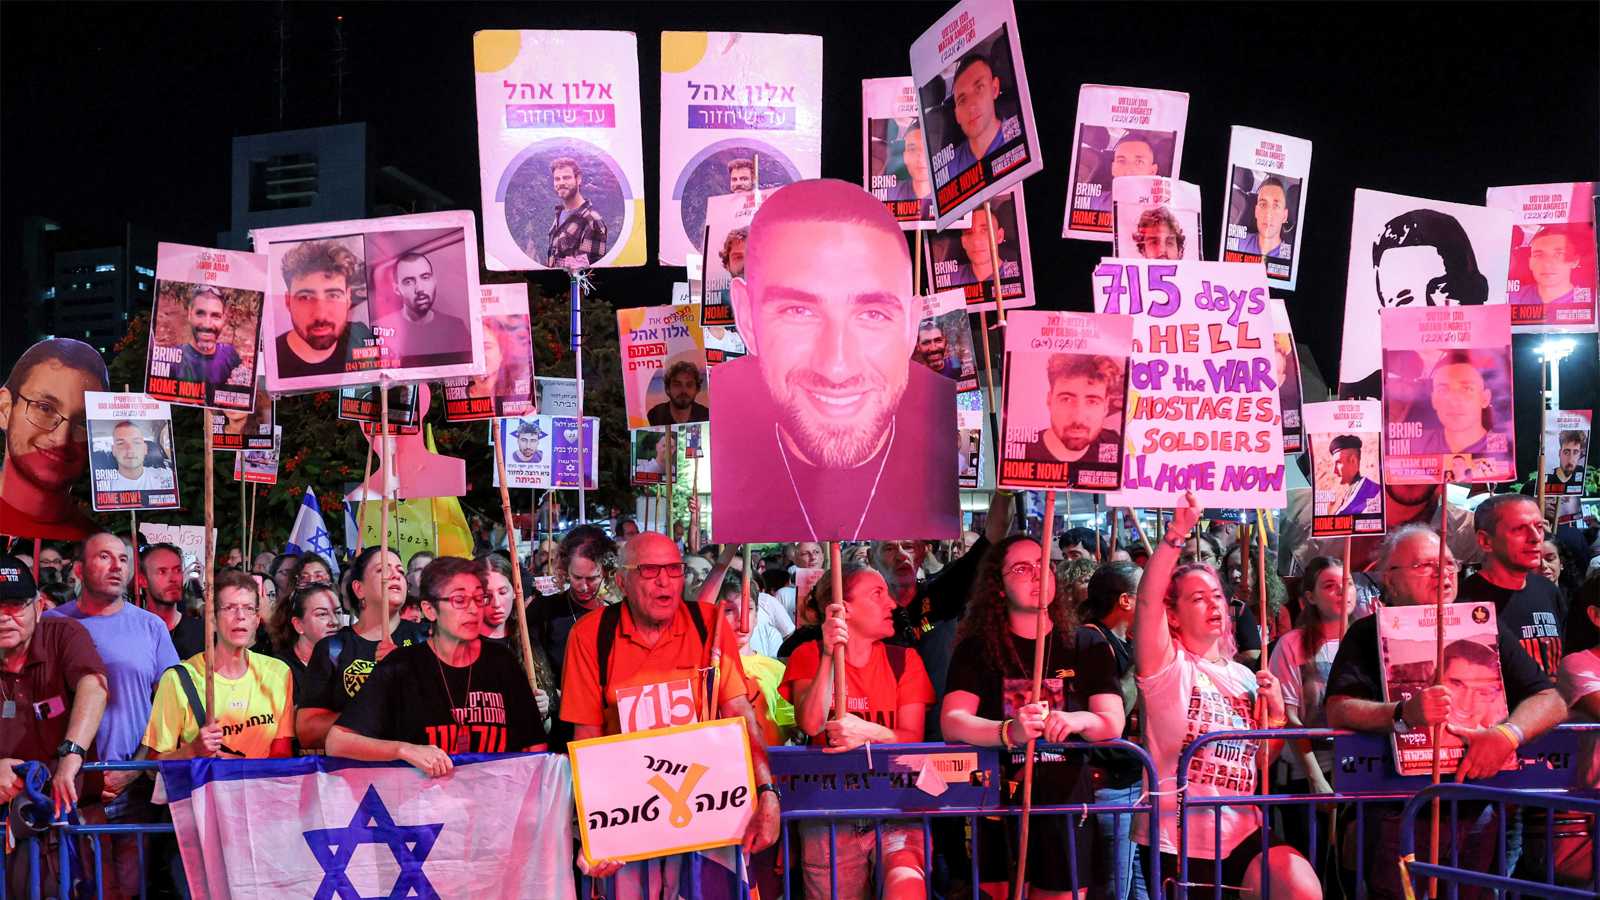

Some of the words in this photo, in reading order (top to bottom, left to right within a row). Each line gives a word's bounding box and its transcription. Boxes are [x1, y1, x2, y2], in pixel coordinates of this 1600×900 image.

[503, 80, 554, 102] אהל
[561, 80, 614, 104] אלון
[687, 80, 736, 101] אהל
[745, 82, 795, 107] אלון
[515, 106, 578, 125] שיחזור
[584, 107, 606, 124] עד
[698, 107, 758, 127] שיחזור
[766, 108, 787, 126] עד
[932, 143, 955, 170] BRING
[871, 174, 897, 189] BRING
[935, 167, 951, 190] HIM
[939, 181, 960, 203] HOME
[959, 161, 984, 191] NOW!
[872, 188, 888, 202] HIM
[1075, 182, 1102, 198] BRING
[897, 200, 920, 216] NOW!
[1073, 196, 1092, 211] HIM
[1071, 210, 1097, 225] HOME
[1097, 212, 1113, 226] NO
[1228, 223, 1248, 239] BRING
[1226, 237, 1240, 251] HIM
[1225, 251, 1245, 263] HOME
[934, 260, 959, 275] BRING
[936, 273, 952, 288] HIM
[706, 292, 721, 305] HIM
[964, 282, 984, 298] OW!
[1094, 263, 1182, 318] 715
[1194, 280, 1266, 328] days
[704, 306, 728, 320] HOME
[1518, 304, 1544, 320] NOW!
[373, 327, 395, 337] לעולם
[629, 328, 659, 342] אהל
[661, 325, 690, 341] אלון
[1149, 320, 1263, 354] HELL
[152, 345, 183, 364] BRING
[630, 344, 664, 358] הביתה
[150, 360, 171, 378] HIM
[628, 359, 664, 371] בחיים
[1131, 358, 1169, 390] OP
[1173, 363, 1206, 392] the
[1203, 357, 1278, 393] WAR
[149, 377, 177, 395] HOME
[178, 381, 207, 398] NOW!
[1133, 395, 1281, 426] HOSTAGES,
[1006, 427, 1039, 444] BRING
[1388, 421, 1424, 440] BRING
[1142, 426, 1272, 455] SOLDIERS
[1388, 439, 1412, 456] HIM
[1004, 442, 1027, 460] HIM
[95, 469, 118, 481] BRING
[1003, 460, 1036, 479] HOME
[1037, 461, 1070, 481] NOW!
[1123, 453, 1154, 491] LL
[1153, 460, 1216, 493] HOME
[1220, 463, 1286, 492] NOW
[96, 480, 111, 491] HIM
[514, 476, 542, 484] הביתה
[96, 491, 120, 504] HOME
[119, 491, 142, 504] NOW!
[1314, 517, 1335, 530] HOME
[1335, 515, 1353, 530] NOW!
[619, 680, 698, 734] 715
[847, 696, 870, 710] HOME
[1214, 742, 1241, 762] נקום
[643, 754, 689, 776] יותר
[695, 784, 748, 813] שנה
[587, 793, 660, 831] טובה
